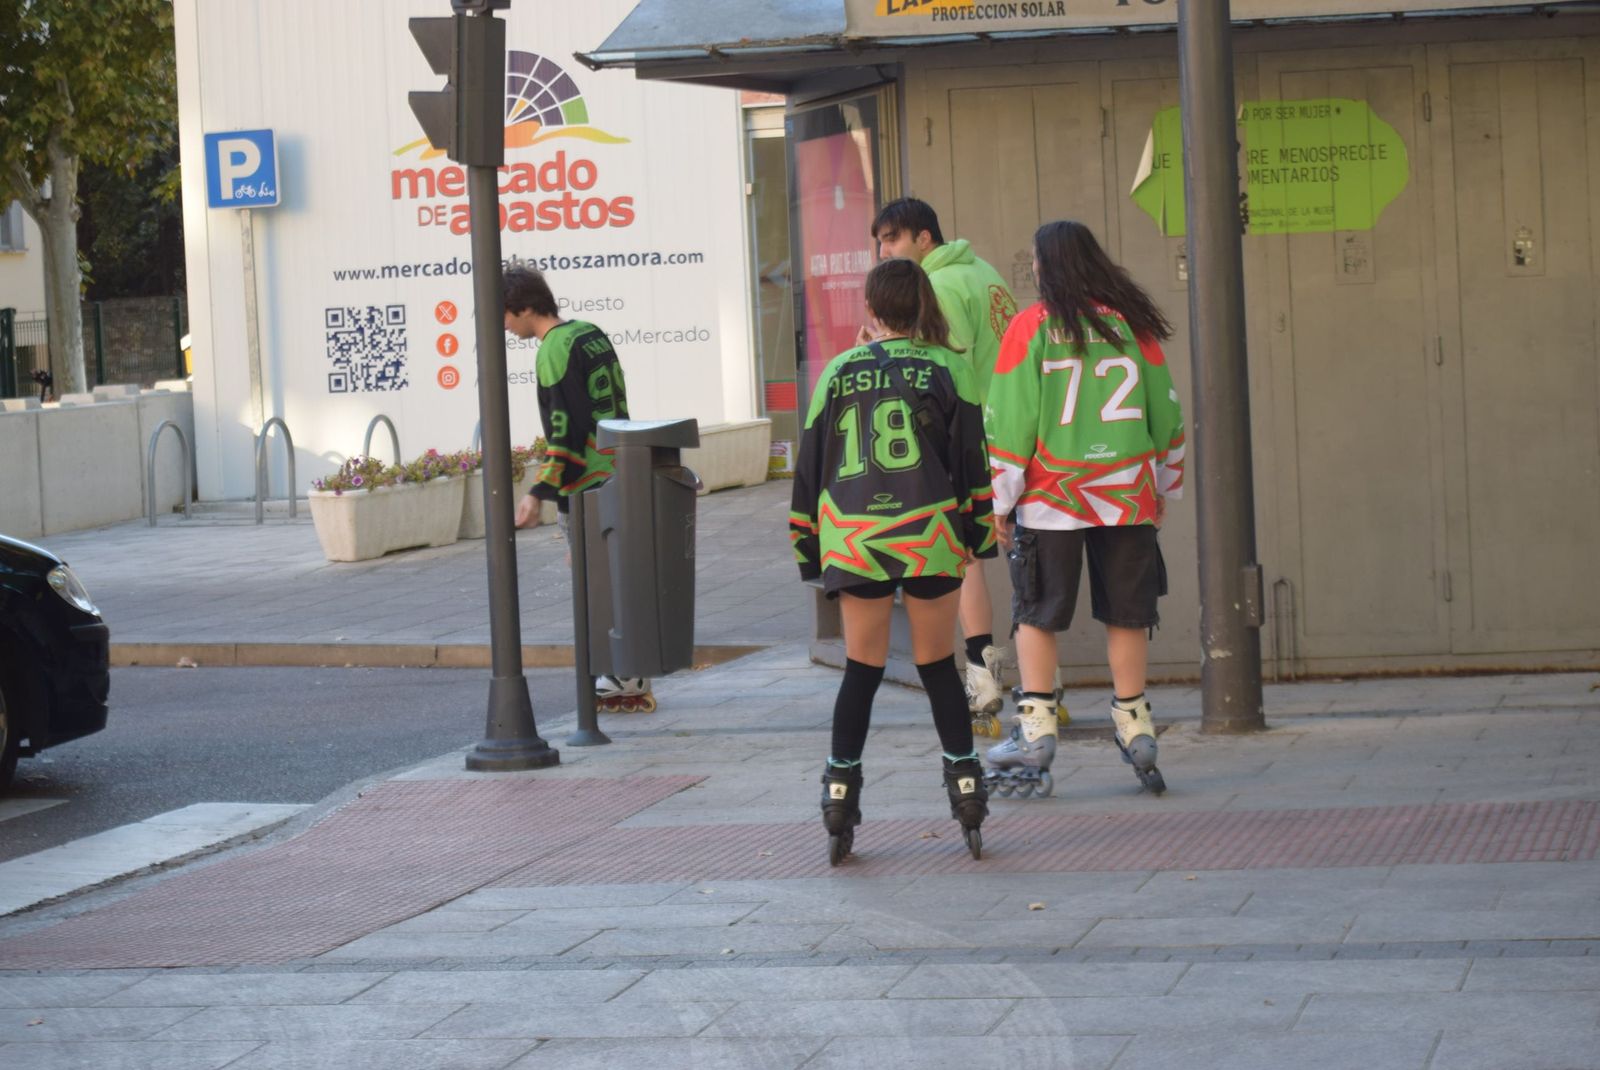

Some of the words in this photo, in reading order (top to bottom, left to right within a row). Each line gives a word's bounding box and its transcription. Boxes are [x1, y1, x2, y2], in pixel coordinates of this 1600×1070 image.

[931, 3, 1017, 21] PROTECCION
[1020, 1, 1066, 18] SOLAR
[1252, 107, 1272, 120] POR
[1276, 106, 1296, 120] SER
[1299, 104, 1332, 119] MUJER
[217, 138, 262, 200] P
[1246, 149, 1270, 165] RE
[1279, 143, 1388, 164] MENOSPRECIE
[391, 150, 598, 200] mecado
[417, 205, 447, 227] DE
[1042, 355, 1143, 427] 72
[836, 395, 922, 483] 18
